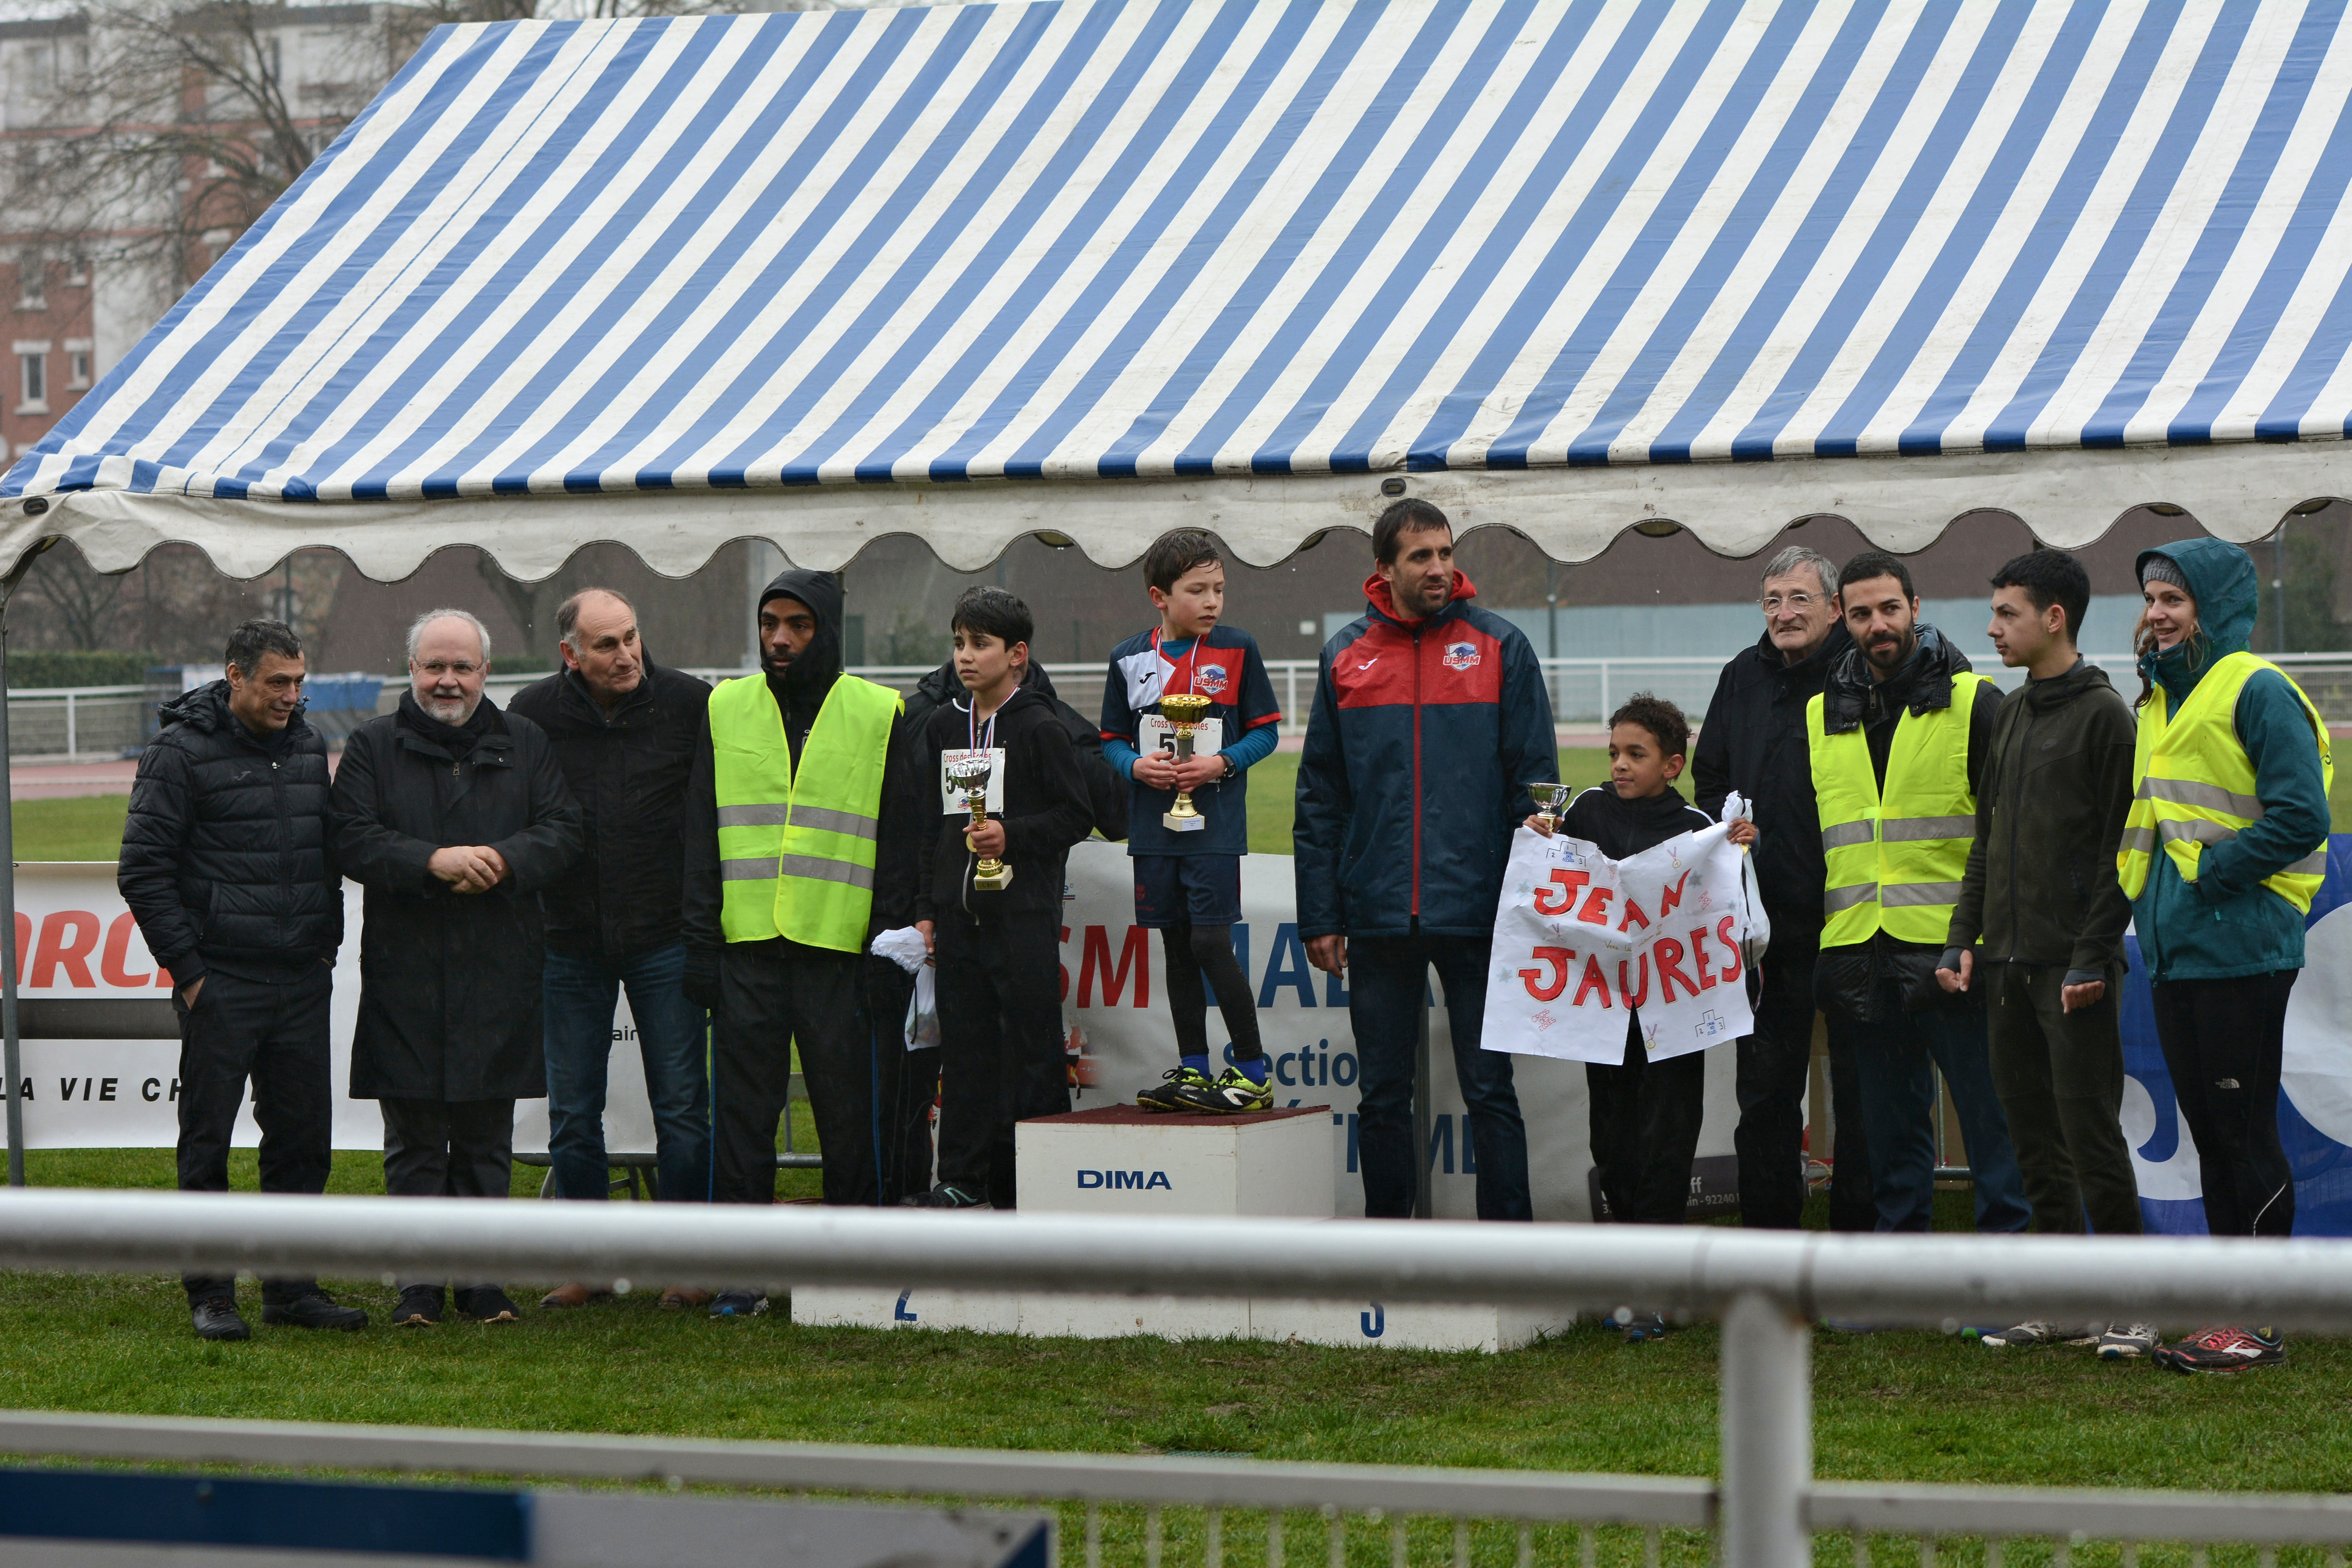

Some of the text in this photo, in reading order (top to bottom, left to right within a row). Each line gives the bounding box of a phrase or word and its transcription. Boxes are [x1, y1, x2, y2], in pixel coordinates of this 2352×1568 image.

[1443, 656, 1481, 665] USMM
[1194, 677, 1228, 690] USMM
[1151, 718, 1168, 728] Cross
[944, 753, 958, 763] Cross
[1534, 868, 1691, 933] JEAN
[1517, 915, 1742, 1010] JAURES
[61, 1078, 118, 1101] VIE
[1077, 1170, 1172, 1190] DIMA
[1705, 1193, 1735, 1205] 92240
